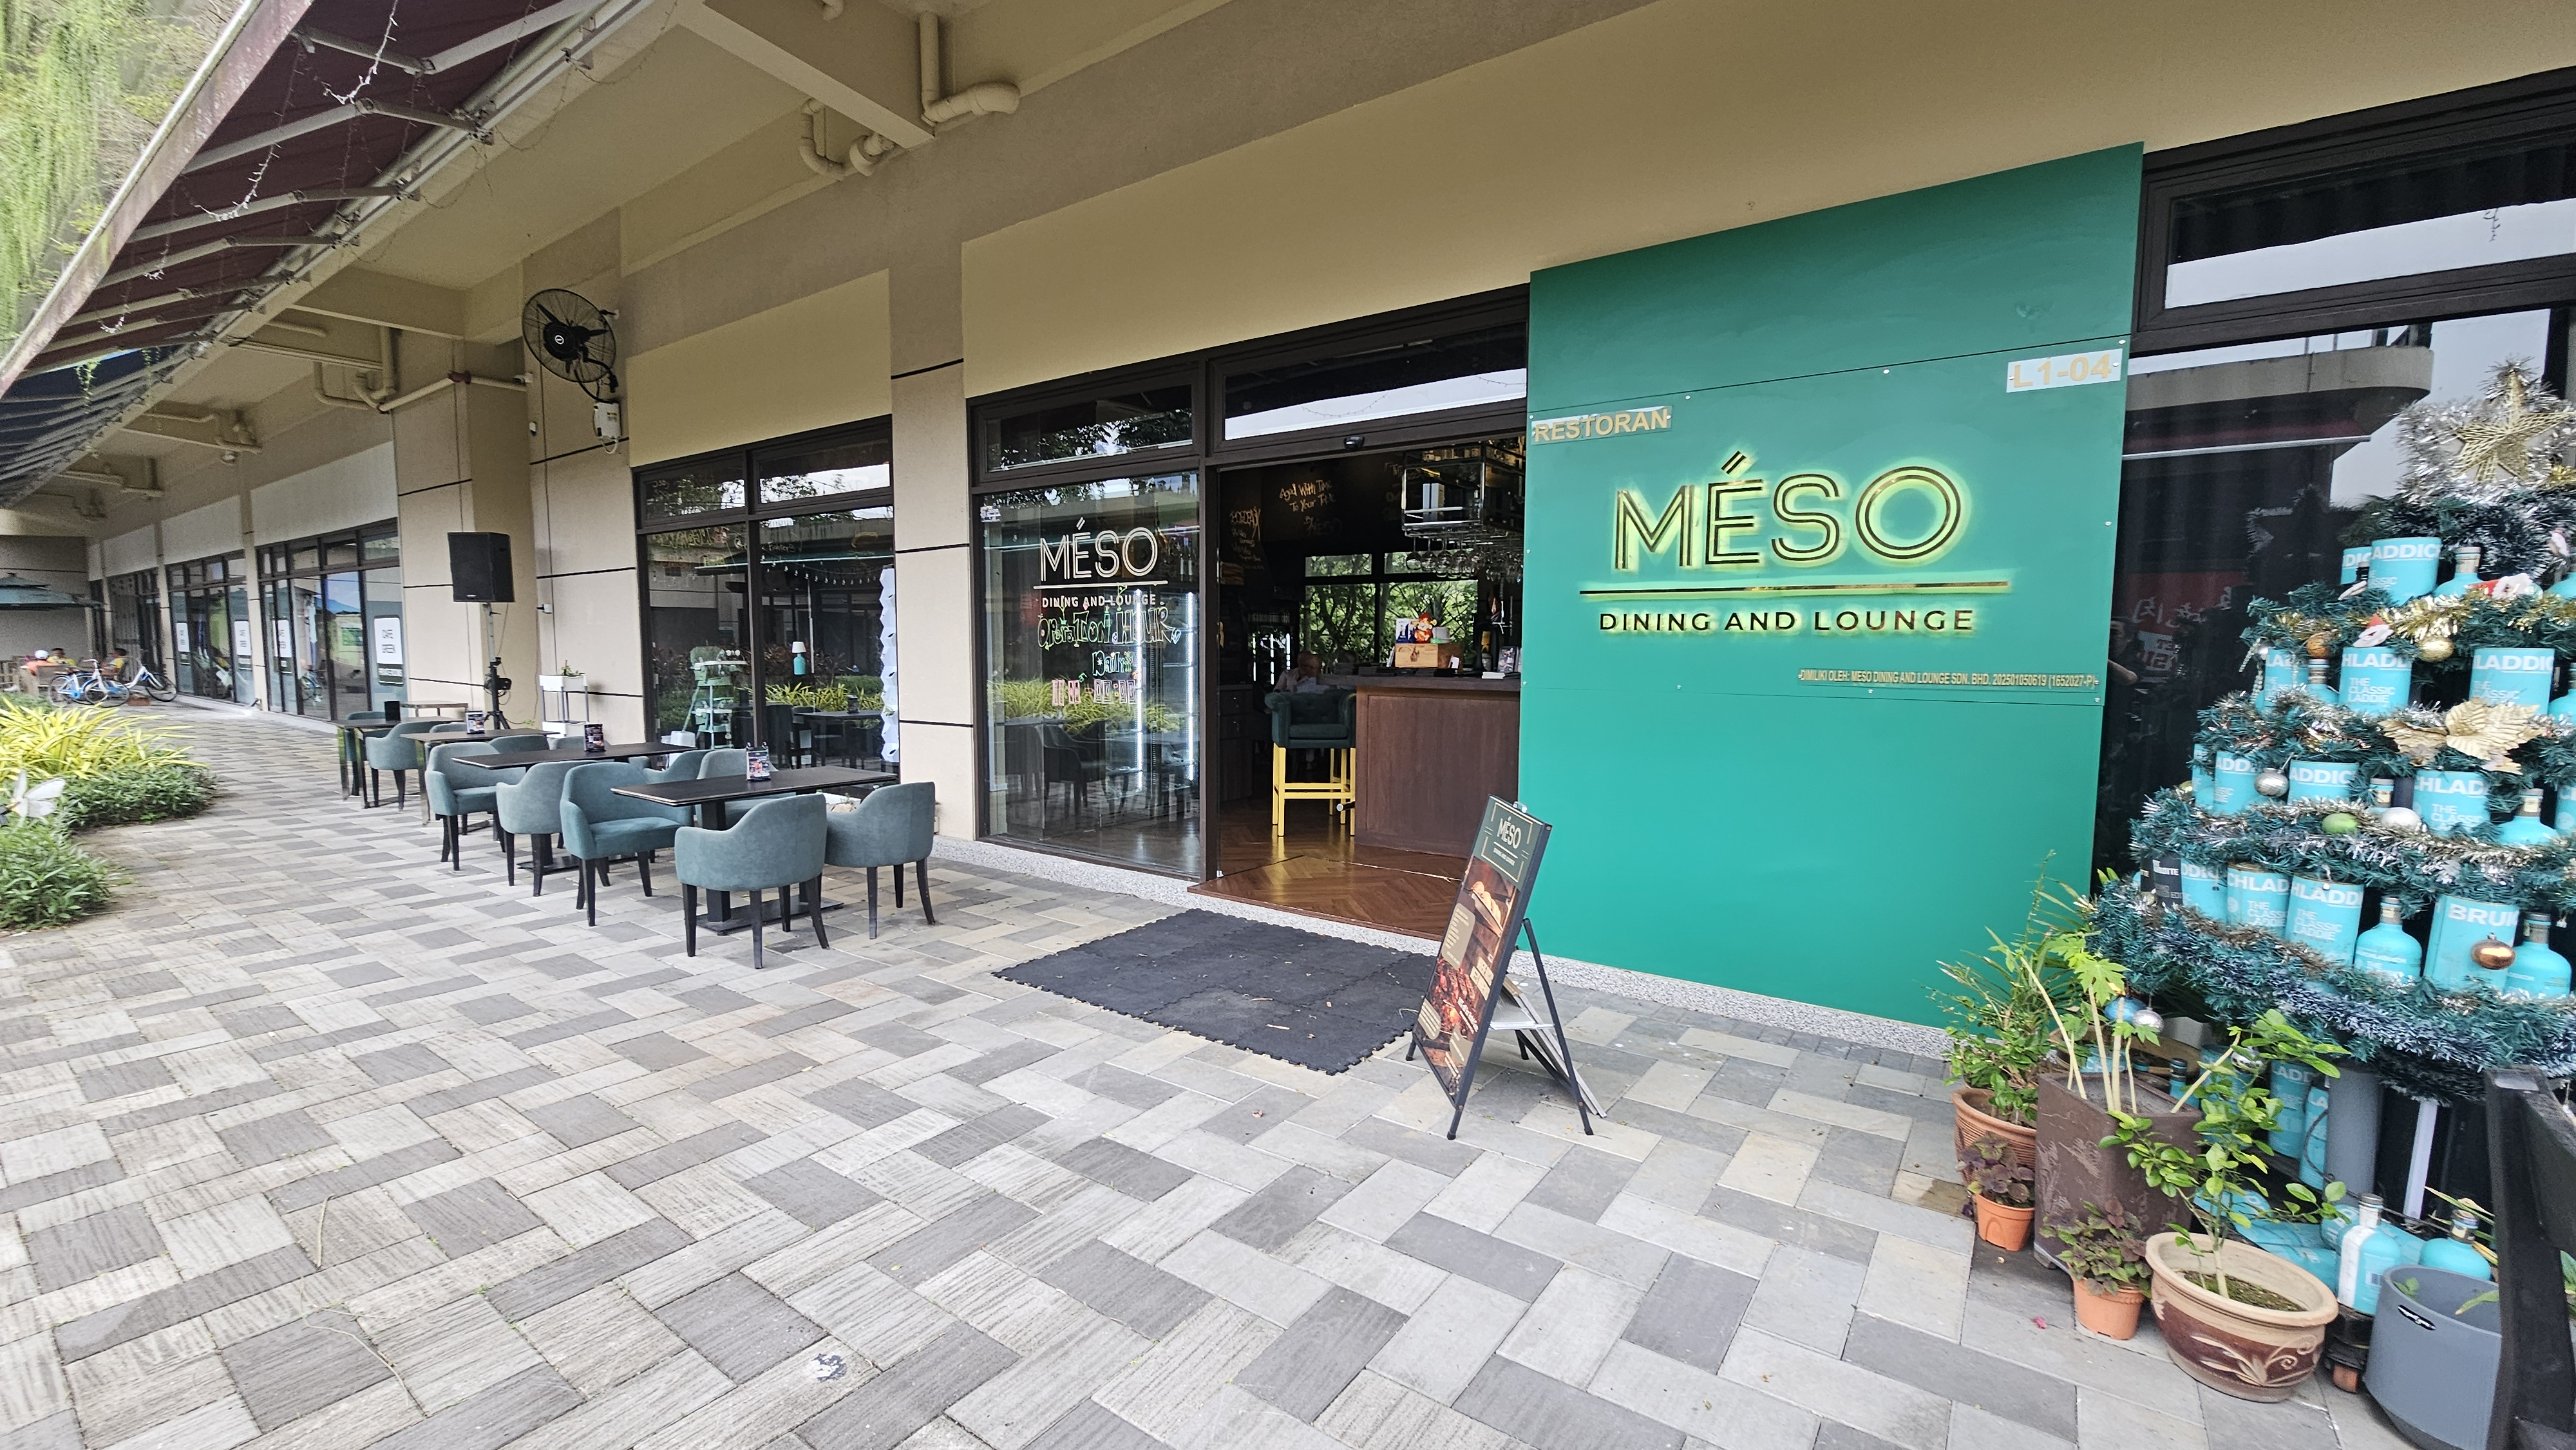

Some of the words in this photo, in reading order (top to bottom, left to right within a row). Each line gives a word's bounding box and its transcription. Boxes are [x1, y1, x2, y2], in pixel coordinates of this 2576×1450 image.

[2013, 353, 2111, 388] L1-04
[1535, 409, 1668, 442] RESTORAN
[1615, 451, 1962, 569] MÉSO
[1040, 517, 1158, 581] MÉSO
[2371, 544, 2440, 559] ADDIC
[1042, 596, 1079, 608] DINING
[1083, 595, 1105, 607] AND
[1600, 612, 1711, 631] DINING
[1724, 611, 1796, 631] AND
[1814, 610, 1974, 631] LOUNGE
[1828, 670, 1850, 681] OLEH:
[1851, 671, 1872, 682] MESO
[1874, 671, 1898, 683] DINING
[1900, 672, 1916, 683] AND
[1917, 672, 1950, 684] LOUNGE
[1951, 673, 1969, 684] SDN.
[1971, 673, 1991, 685] BHD.
[2415, 776, 2490, 796] HLAD
[2431, 803, 2458, 813] THE
[2292, 882, 2363, 906] HLADD
